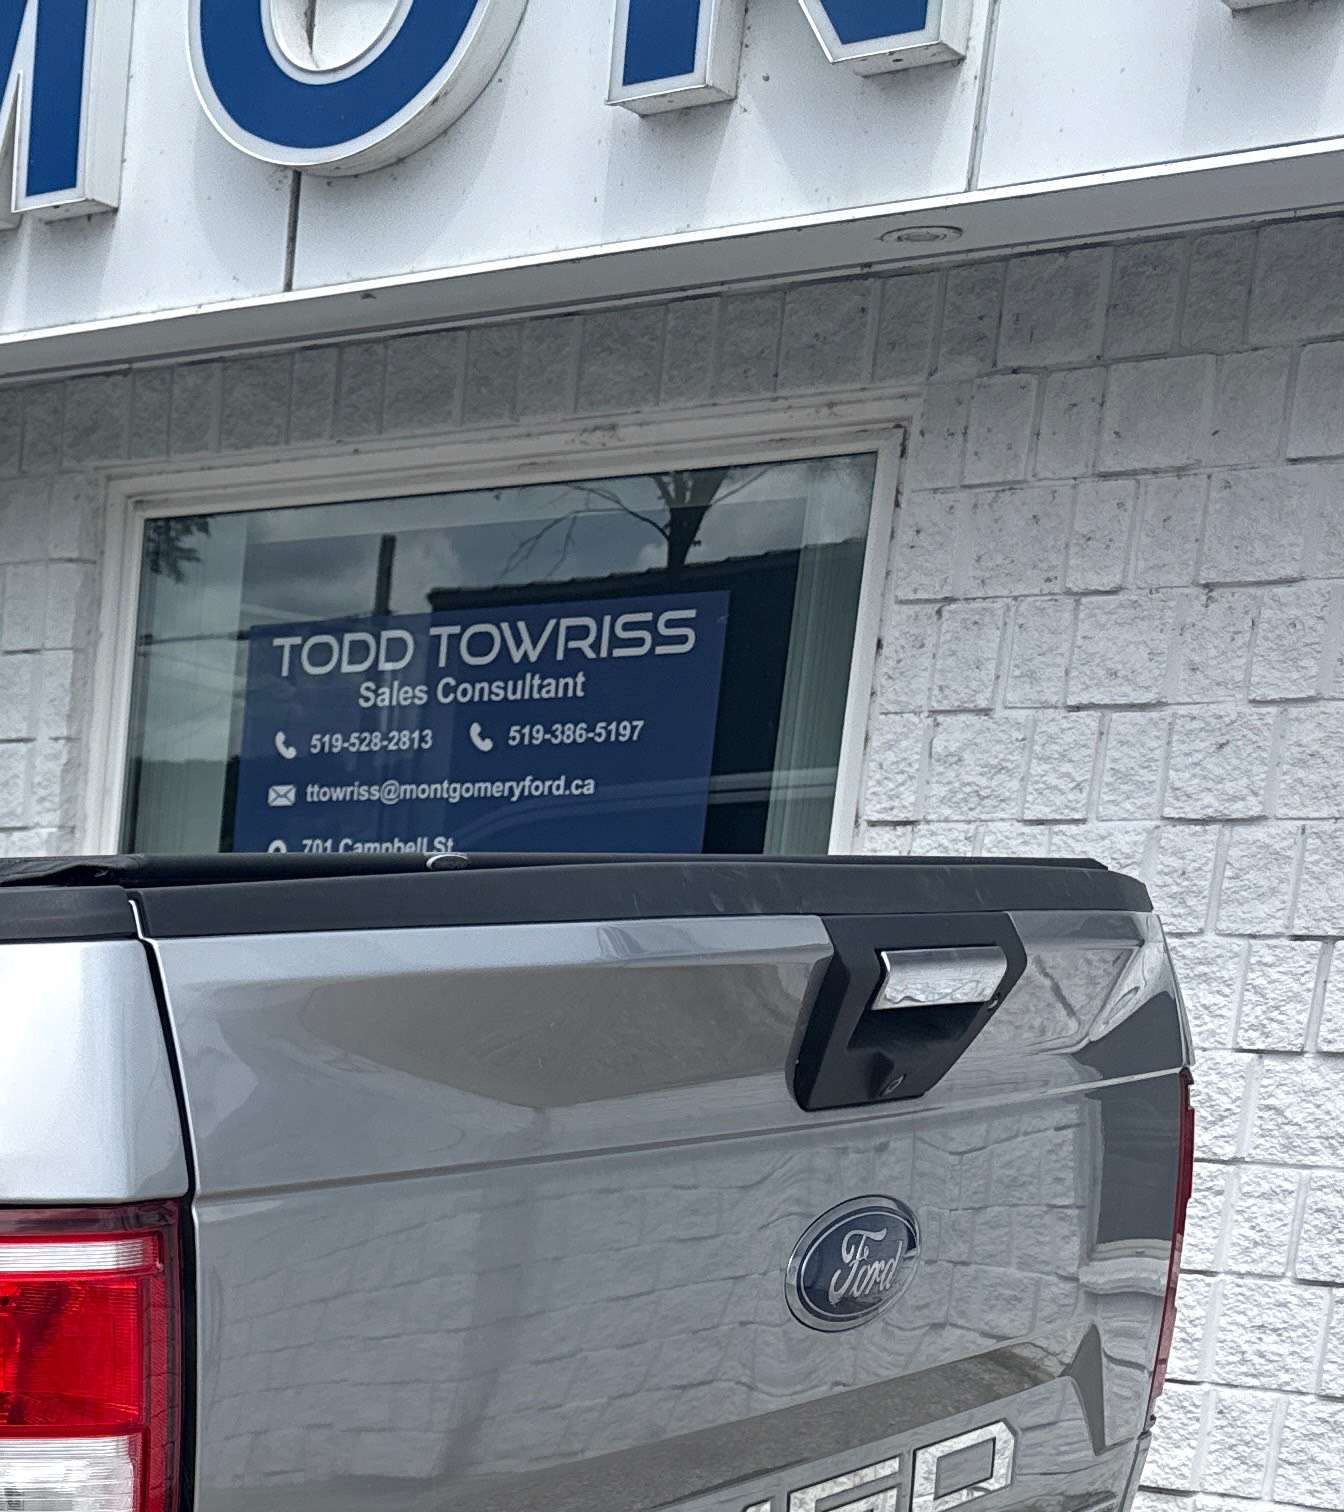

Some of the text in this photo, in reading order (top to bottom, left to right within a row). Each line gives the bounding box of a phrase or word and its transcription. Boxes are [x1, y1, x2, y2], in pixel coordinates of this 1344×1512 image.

[273, 609, 697, 677] TODD TOWRISS
[358, 671, 586, 708] Sales Consultant
[310, 729, 433, 754] 519-528-2813
[508, 720, 644, 746] 519-386-5197
[305, 775, 596, 805] ttowriss@montgomeryford.ca
[302, 838, 333, 853] 701
[828, 1227, 903, 1305] Ford
